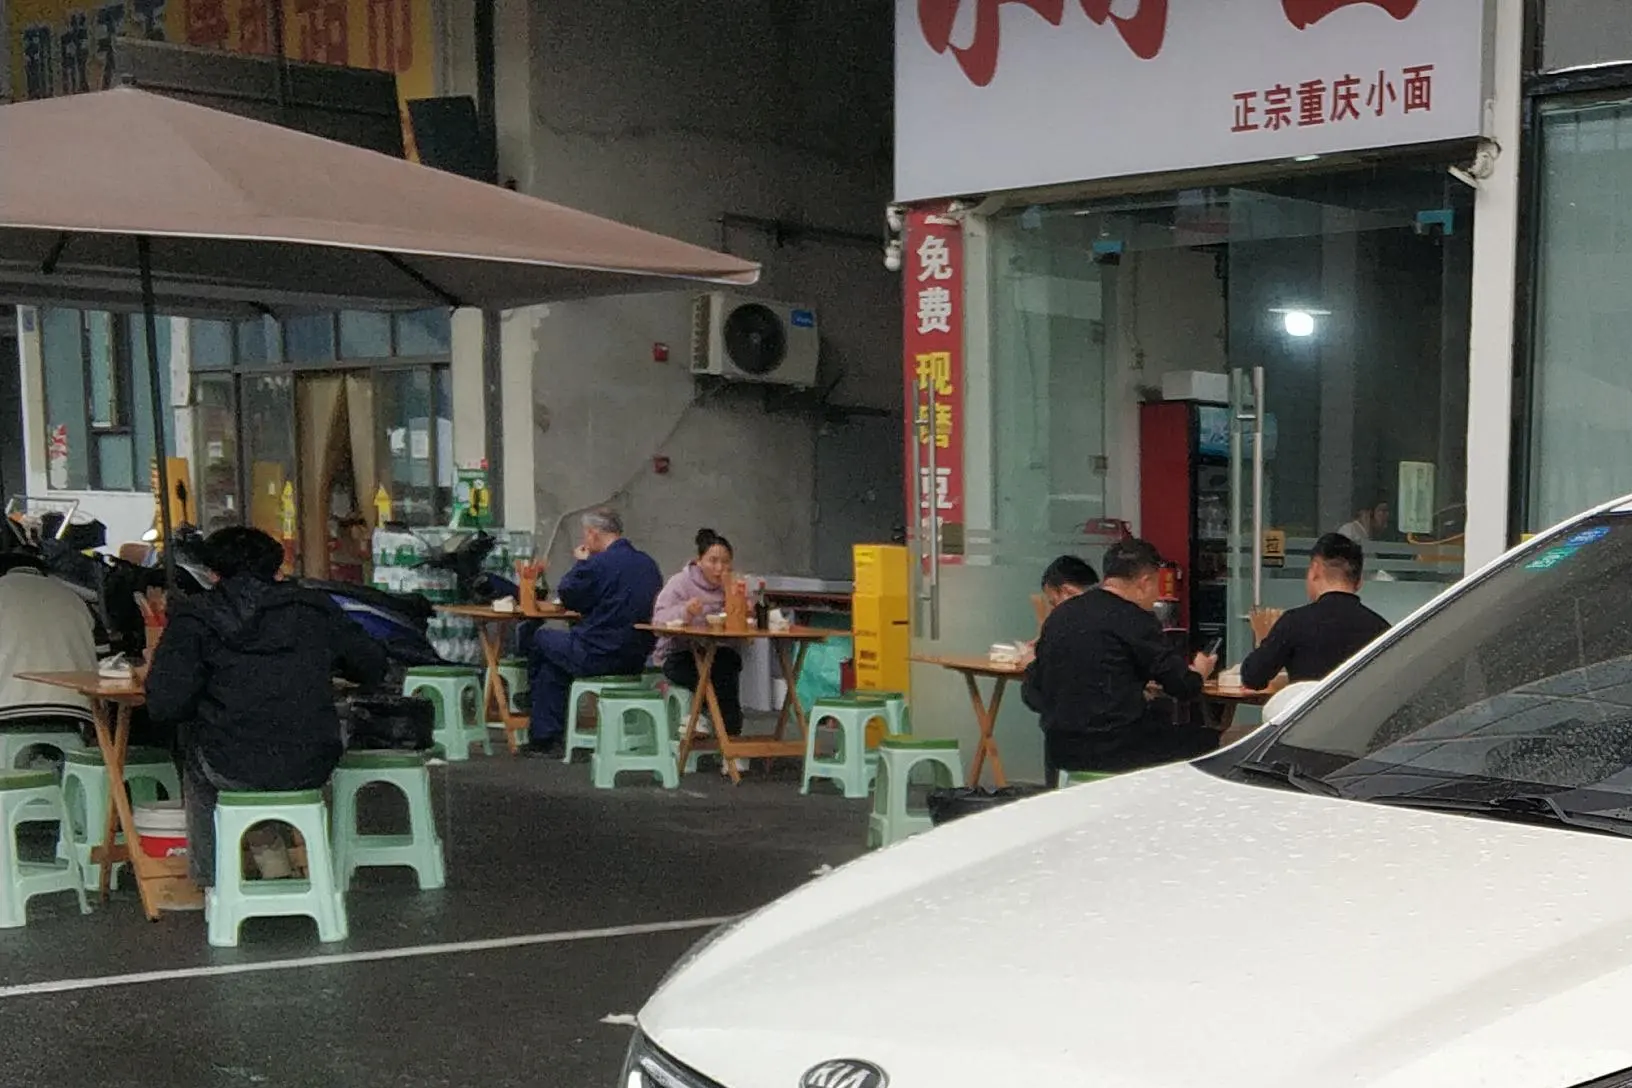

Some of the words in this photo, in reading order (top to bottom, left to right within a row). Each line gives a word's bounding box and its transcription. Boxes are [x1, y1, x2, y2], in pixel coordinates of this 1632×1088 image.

[1231, 64, 1434, 132] 正宗重庆小面
